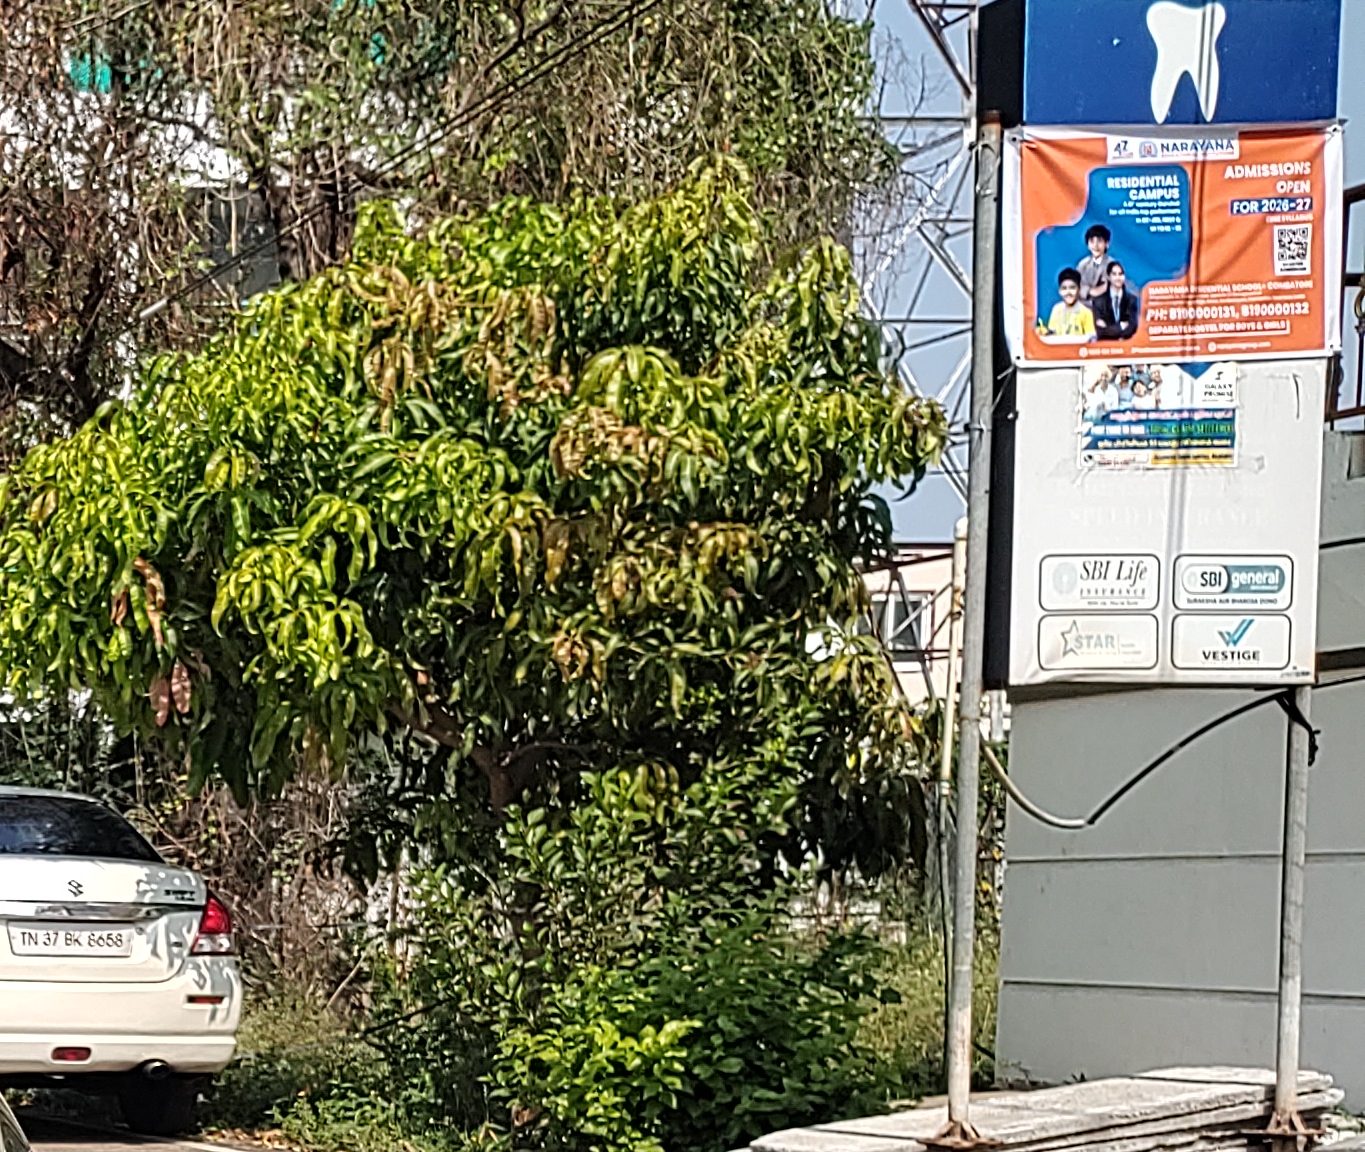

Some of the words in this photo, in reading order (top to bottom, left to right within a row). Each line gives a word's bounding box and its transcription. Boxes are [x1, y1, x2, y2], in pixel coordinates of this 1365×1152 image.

[1161, 139, 1234, 152] NARAYANA
[1224, 162, 1311, 179] ADMISSIONS
[1107, 175, 1180, 189] RESIDENTIAL
[1276, 180, 1311, 193] OPEN
[1129, 188, 1180, 200] CAMPUS
[1233, 200, 1259, 214] FOR
[1261, 198, 1311, 212] 2026-27
[1080, 560, 1111, 581] SBI
[1116, 560, 1147, 587] Life
[1200, 571, 1222, 587] SBI
[1231, 569, 1279, 588] general
[1074, 634, 1115, 649] STAR
[1202, 650, 1261, 661] VESTIGE
[21, 931, 38, 946] TN
[43, 931, 59, 946] 37
[65, 933, 81, 947] BK
[88, 932, 123, 947] 8658
